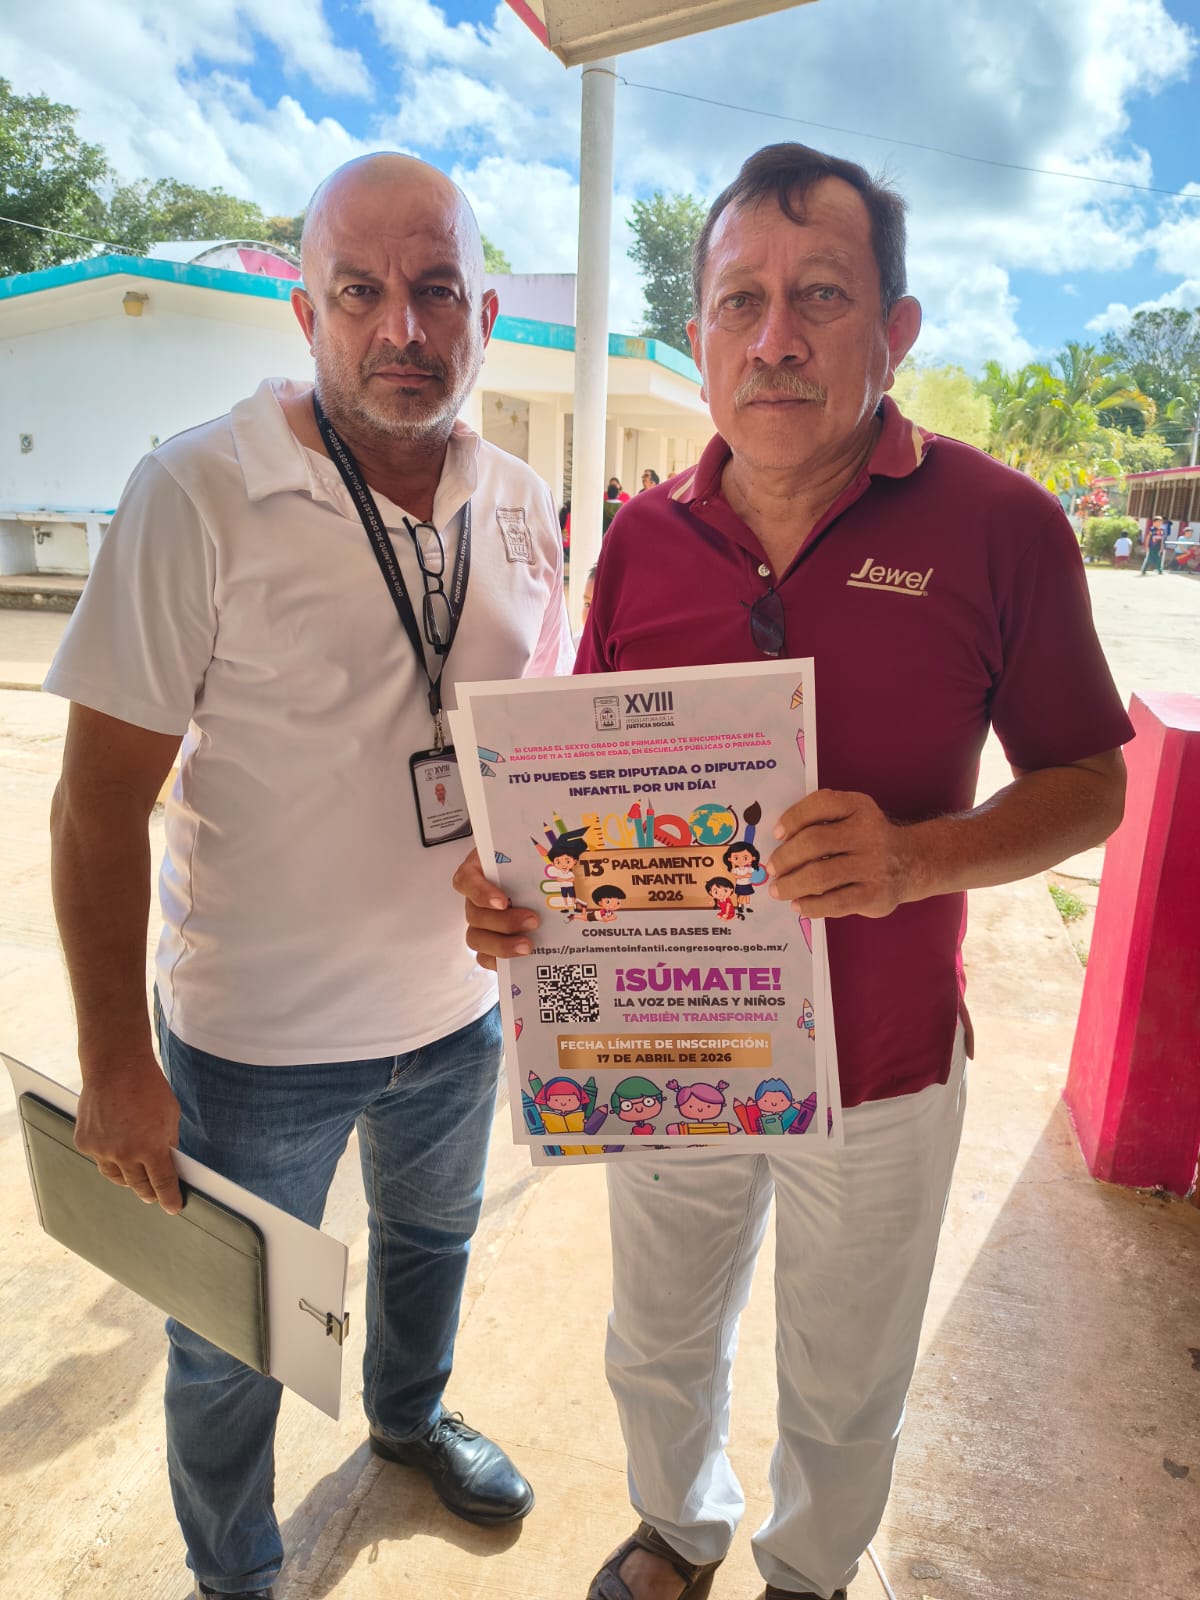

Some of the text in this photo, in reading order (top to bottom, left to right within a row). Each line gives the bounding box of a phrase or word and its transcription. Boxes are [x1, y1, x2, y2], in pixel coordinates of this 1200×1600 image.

[327, 428, 342, 451] PODER
[337, 450, 362, 490] LEGISLATIVO
[358, 490, 367, 503] DEL
[363, 502, 380, 531] ESTADO
[375, 531, 384, 542] DE
[379, 541, 398, 581] QUINTANA
[850, 558, 934, 591] Jewel
[624, 691, 674, 714] XVIII
[626, 722, 651, 730] JUSTICIA
[689, 734, 742, 742] ENCUENTRAS
[573, 750, 595, 758] AÑOS
[685, 743, 723, 751] PÚBLICAS
[732, 740, 772, 748] PRIVADAS
[434, 764, 450, 774] XVIII
[508, 759, 777, 784] ¡TÚ PUEDES SER DIPUTADA O DIPUTADO
[569, 779, 716, 797] INFANTIL POR UN DÍA!
[611, 856, 715, 870] PARLAMENTO
[631, 873, 697, 886] INFANTIL
[648, 890, 684, 902] 2026
[581, 927, 732, 937] CONSULTA LAS BASES EN:
[615, 962, 782, 992] ¡SÚMATE!
[614, 995, 786, 1008] ¡LA VOZ DE NIÑAS Y NIÑOS
[622, 1010, 779, 1023] TAMBIÉN TRANSFORMA!
[560, 1036, 769, 1050] FECHA LÍMITE DE INSCRIPCIÓN:
[597, 1053, 733, 1064] 17 DE ABRIL DE 2026
